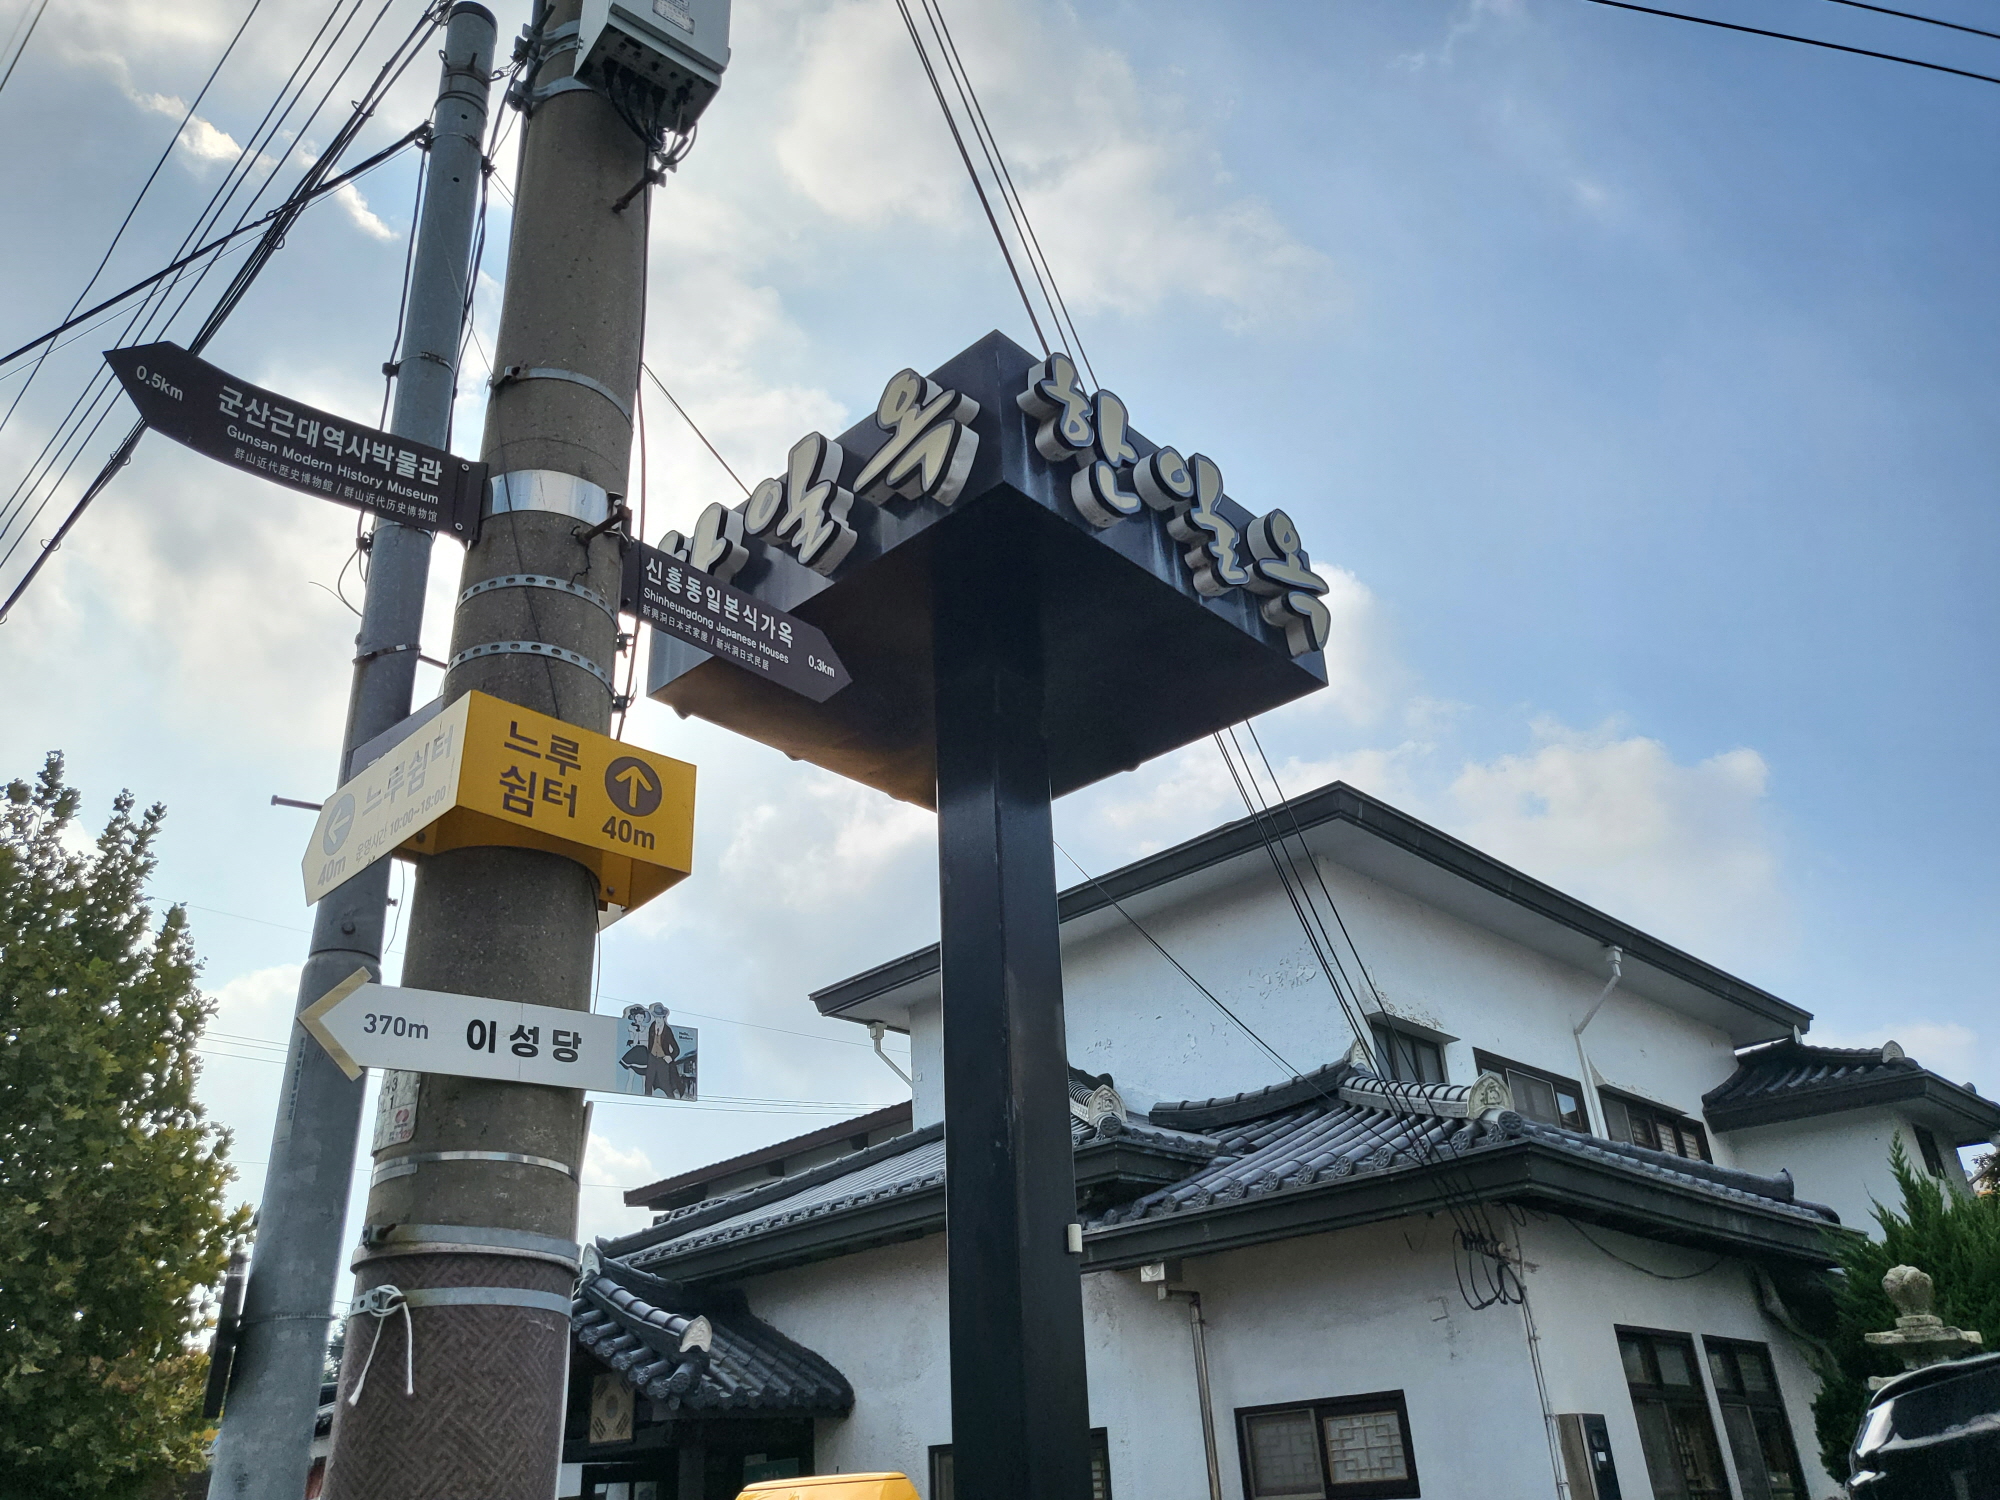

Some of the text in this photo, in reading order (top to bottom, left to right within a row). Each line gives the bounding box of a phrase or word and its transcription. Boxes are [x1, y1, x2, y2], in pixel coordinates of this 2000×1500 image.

[136, 365, 184, 401] 0.5km
[218, 385, 443, 486] 군산근대역사박물관
[227, 425, 439, 504] Gunsan Modern History Museum
[1024, 352, 1331, 653] 한일옥
[643, 587, 789, 664] Shinheungdong Japanese Houses
[646, 557, 794, 649] 신흥동일본식가옥
[808, 655, 835, 678] 0.3km
[503, 720, 582, 776] 느루
[499, 765, 578, 818] 쉼터
[355, 785, 446, 862] 운영시간 10:00~18:00
[602, 815, 655, 850] 40m
[317, 856, 346, 887] 40m
[363, 1013, 429, 1040] 370m
[466, 1019, 582, 1063] 이성당
